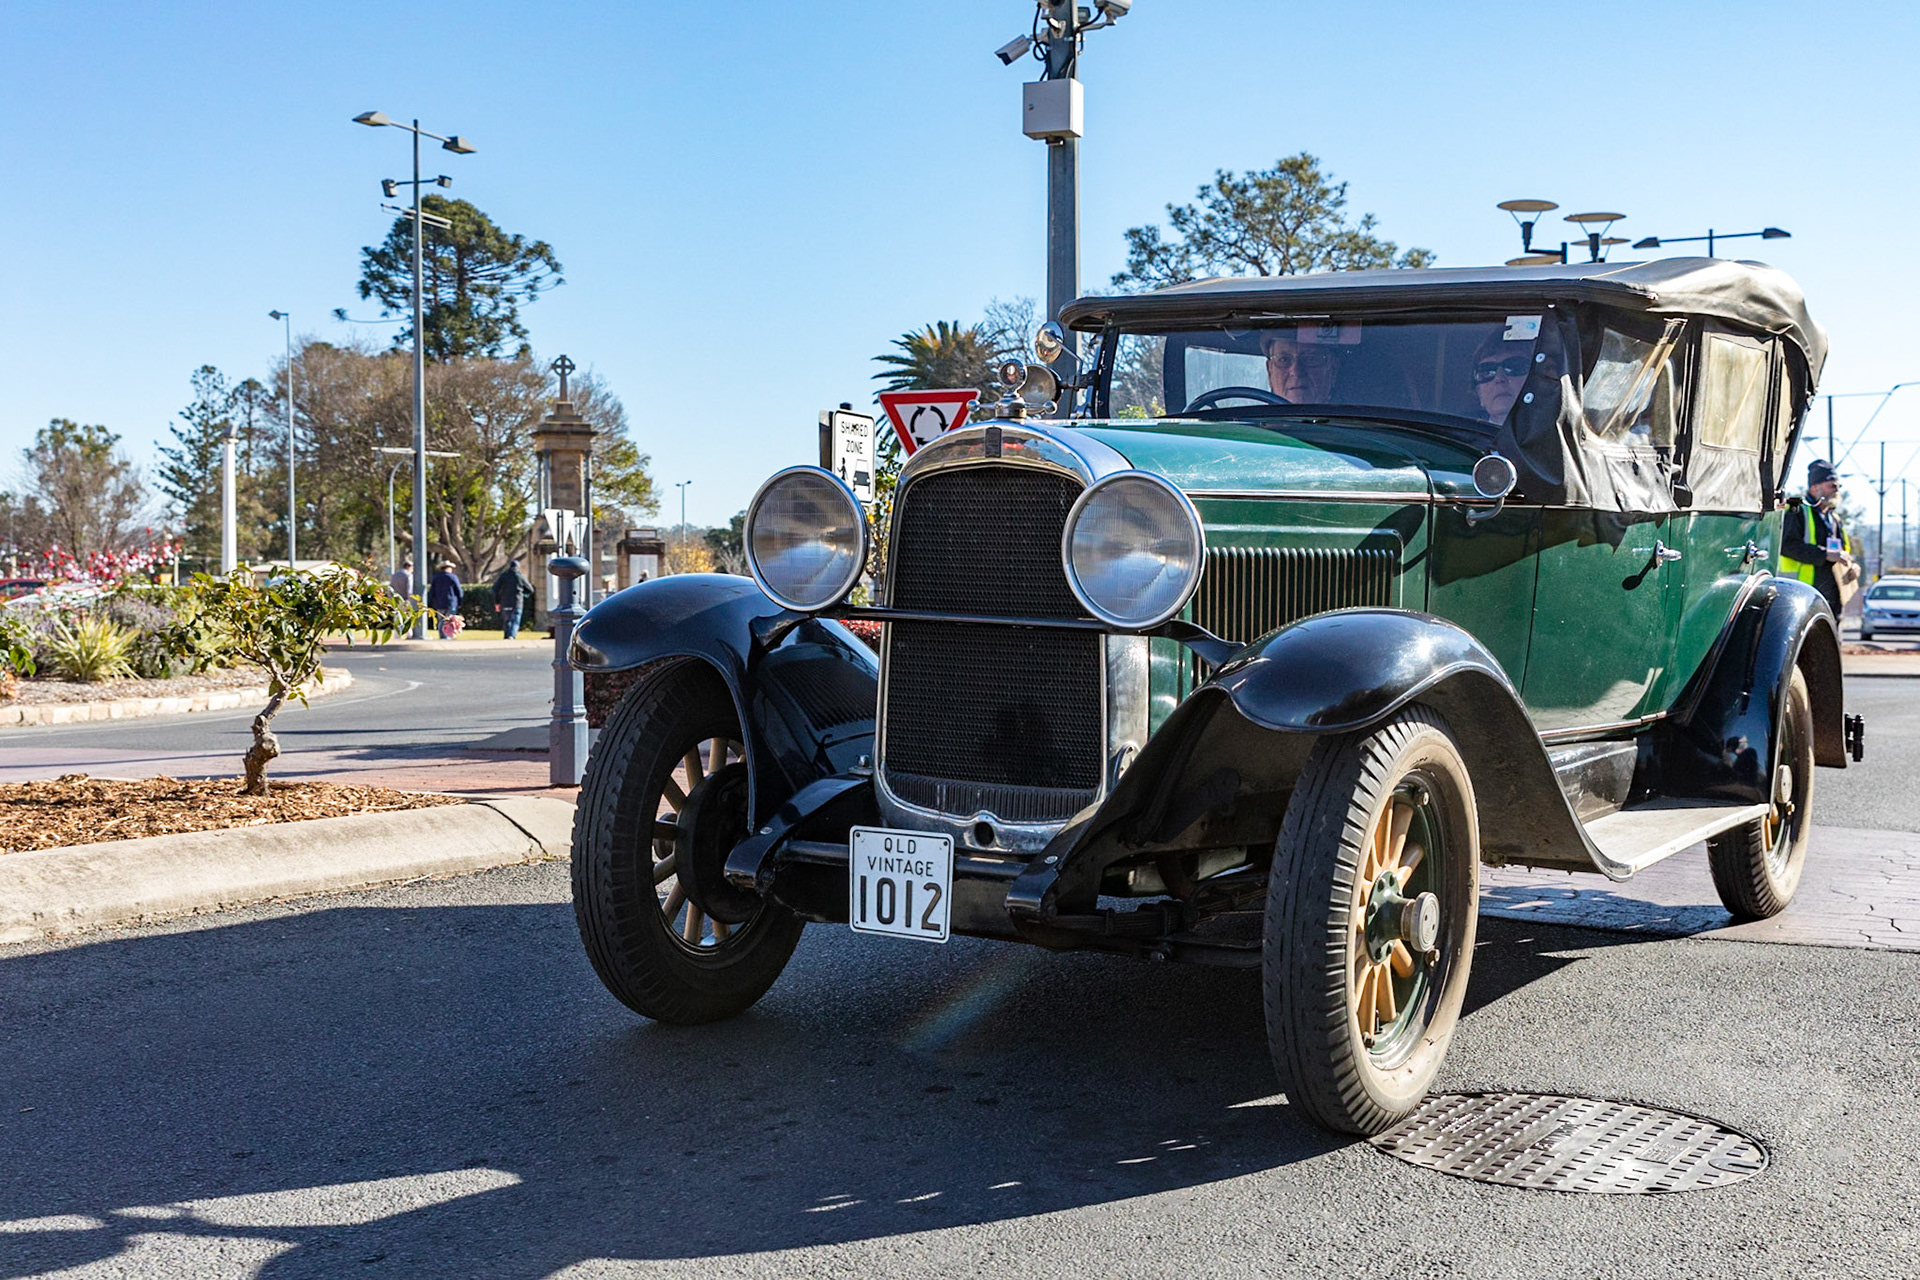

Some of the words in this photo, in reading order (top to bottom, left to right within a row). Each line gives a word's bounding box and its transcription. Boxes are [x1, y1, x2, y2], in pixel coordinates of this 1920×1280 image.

[841, 421, 869, 437] SHARED
[846, 439, 863, 454] ZONE
[884, 837, 917, 855] QLD
[867, 855, 934, 877] VINTAGE
[860, 875, 942, 931] 1012
